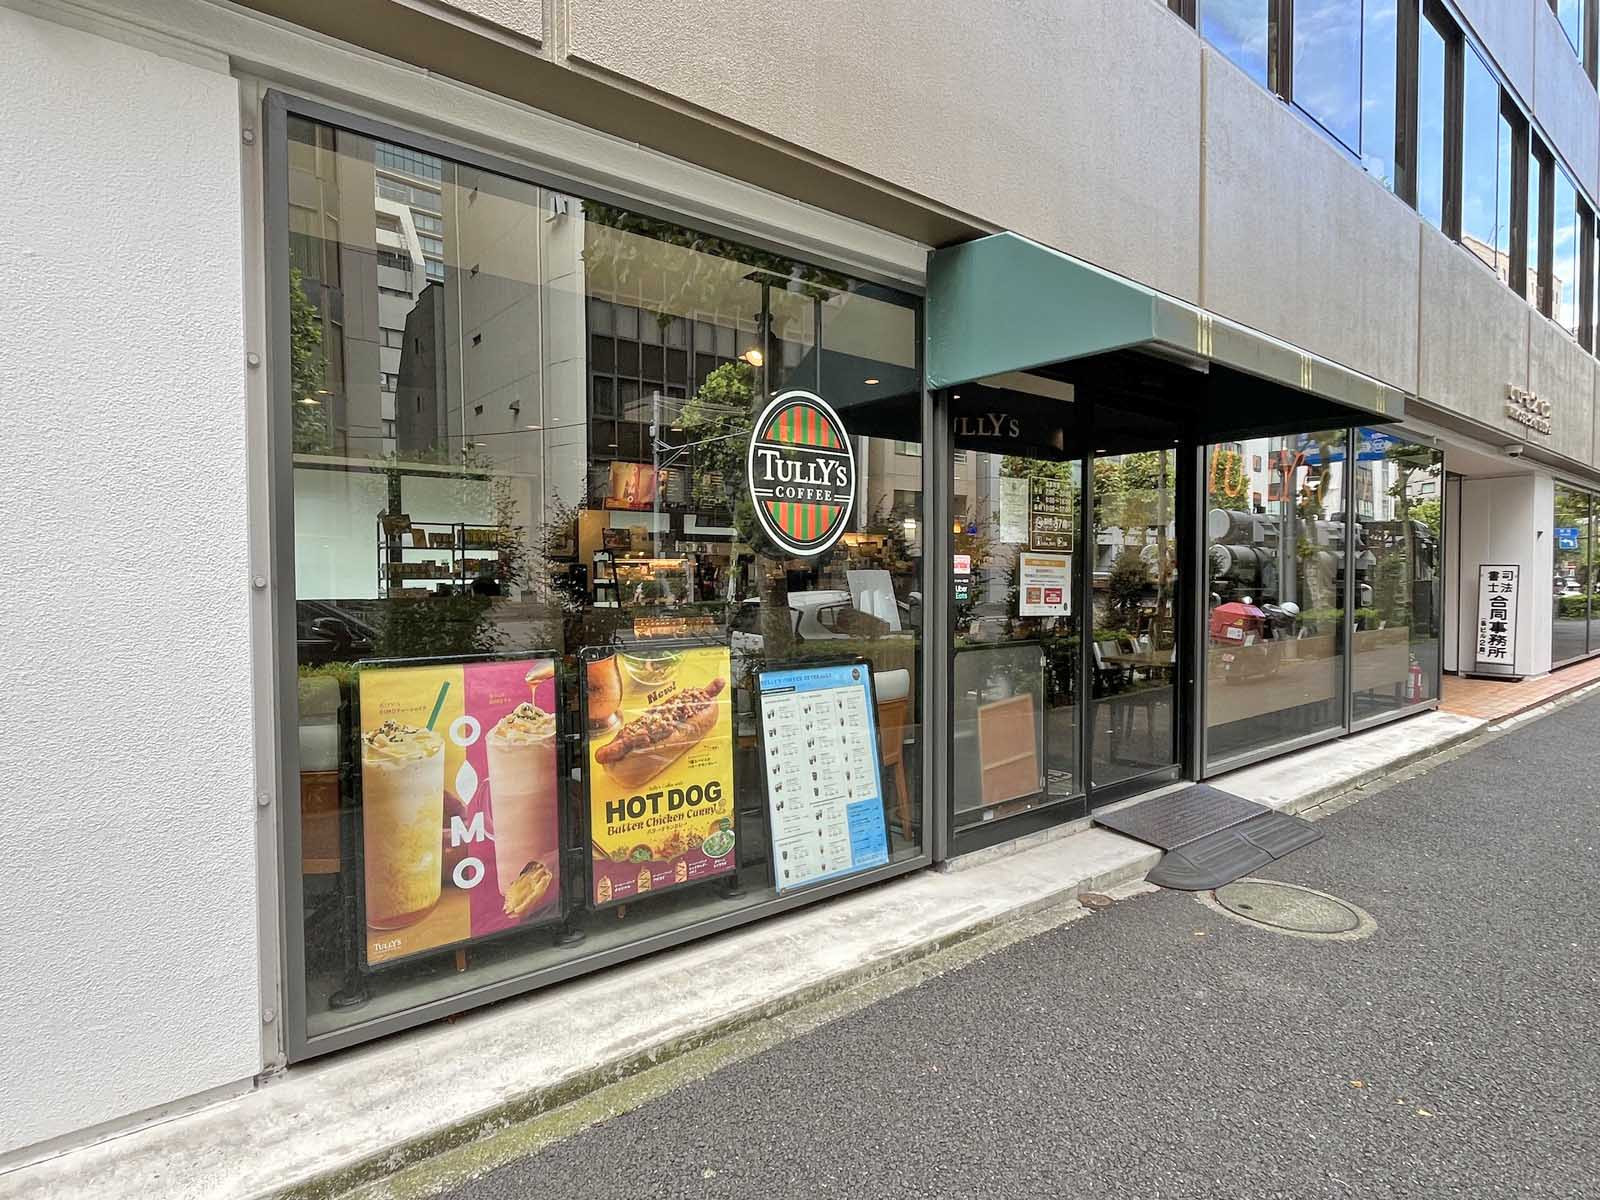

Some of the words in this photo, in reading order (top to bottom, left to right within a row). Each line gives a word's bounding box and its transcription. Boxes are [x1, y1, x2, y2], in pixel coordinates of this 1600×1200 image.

[758, 450, 848, 488] TULLY'S
[775, 485, 832, 501] COFFEE
[955, 585, 968, 593] Uber
[955, 592, 968, 600] Eats
[1487, 595, 1509, 659] 合同事務所
[605, 792, 663, 824] HOT
[668, 781, 722, 811] DOG
[607, 820, 644, 836] Butter
[646, 813, 684, 828] Chicken
